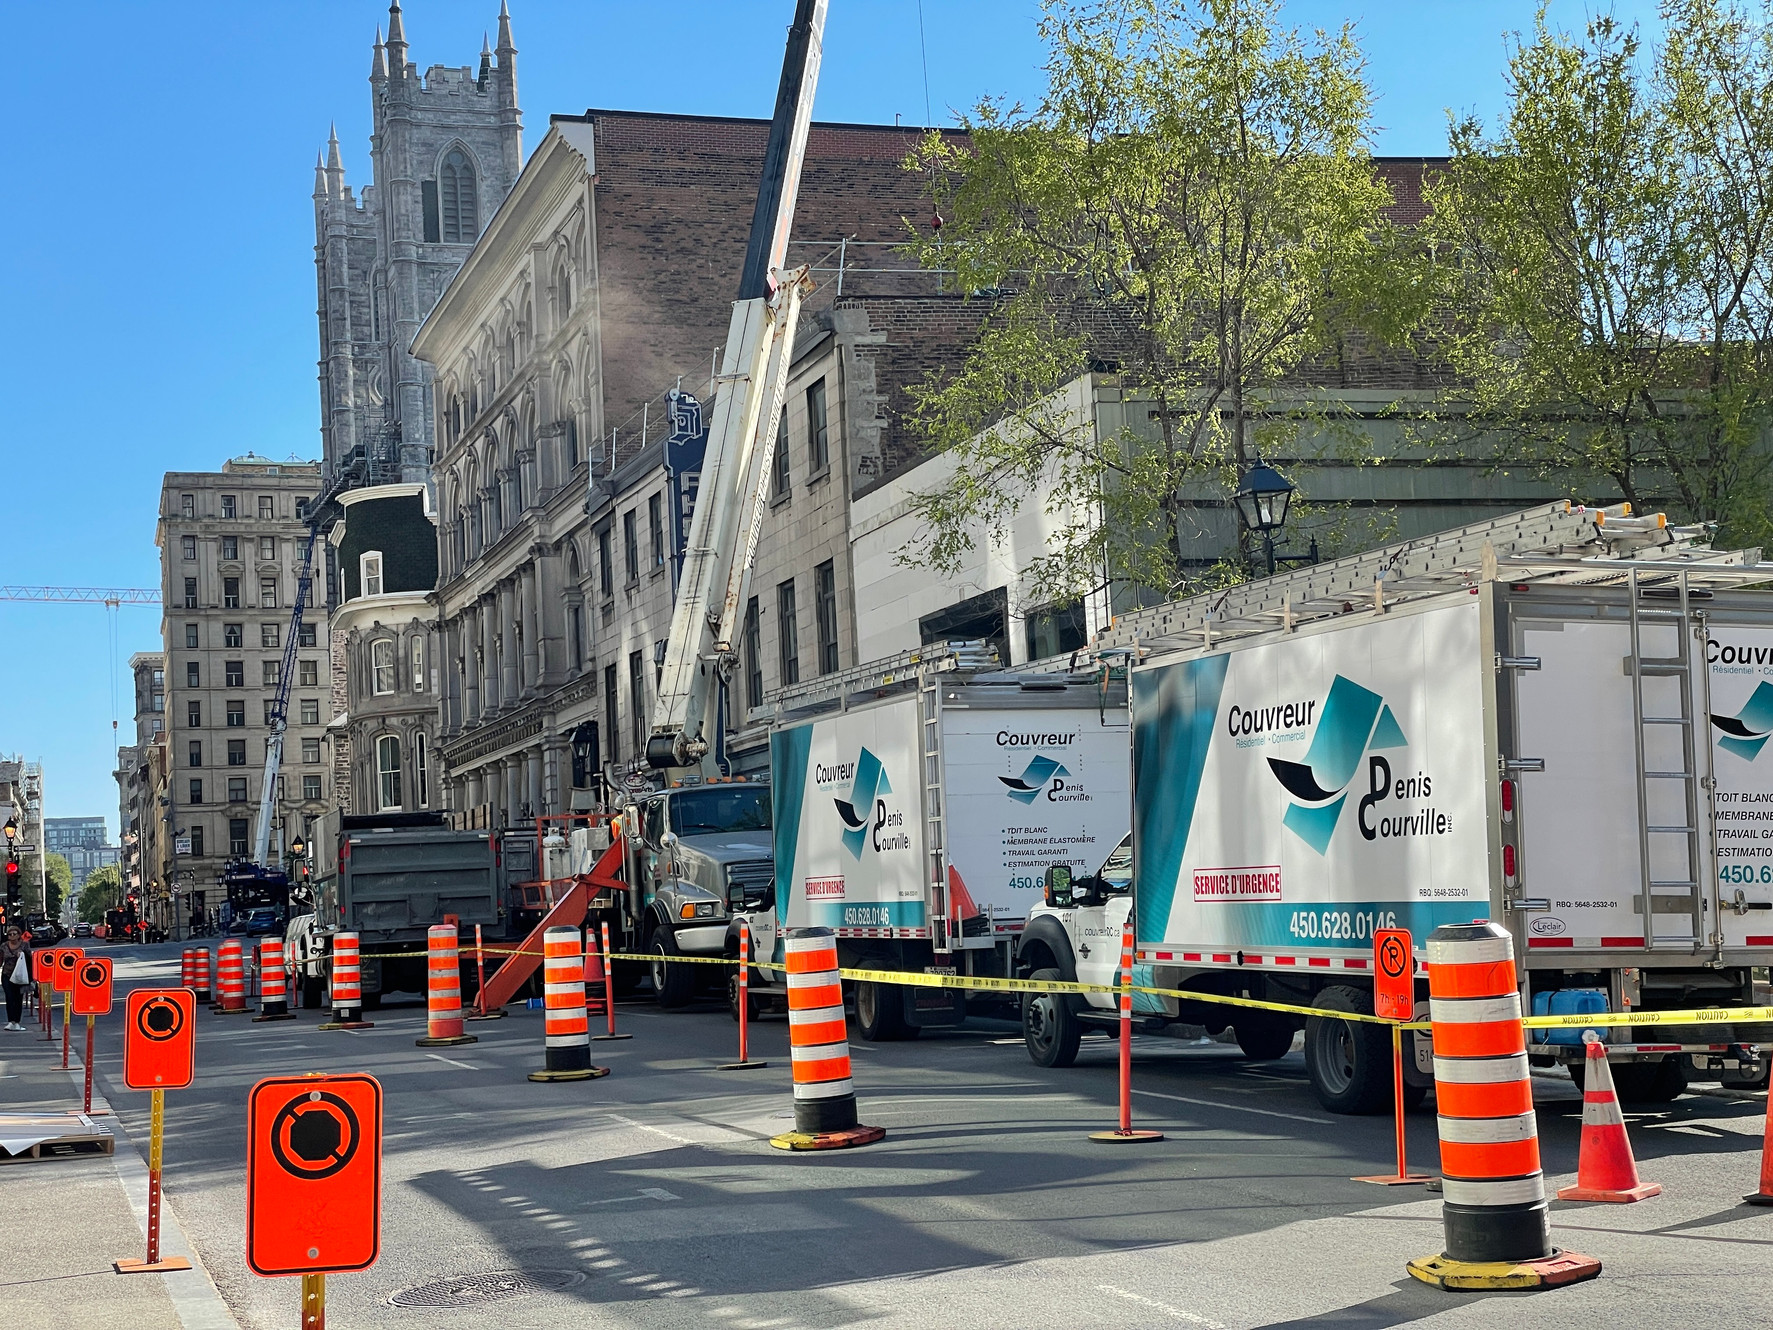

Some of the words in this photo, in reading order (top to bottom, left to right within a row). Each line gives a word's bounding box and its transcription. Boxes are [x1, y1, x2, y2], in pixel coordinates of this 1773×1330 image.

[1712, 665, 1754, 675] Résidentiel
[1228, 700, 1316, 737] Couvreur
[996, 731, 1076, 746] Couvreur
[1271, 730, 1306, 744] Commercial
[816, 762, 855, 784] Couvreur
[1369, 756, 1432, 801] Denis
[1053, 778, 1084, 792] Denis
[1716, 793, 1739, 803] TOIT
[876, 799, 903, 828] Denis
[1358, 793, 1446, 841] Courville
[873, 822, 909, 853] Courville
[1716, 829, 1759, 839] TRAVAIL
[1006, 837, 1048, 846] MEMBRANE
[1007, 849, 1036, 857] TRAVAIL
[1037, 848, 1069, 856] GARANTI
[1716, 847, 1773, 857] ESTIMATIO
[1007, 860, 1051, 868] ESTIMATION
[1051, 859, 1086, 867] GRATUITE
[805, 881, 822, 895] SERVICE
[822, 880, 845, 894] D'URGENCE
[1194, 875, 1230, 895] SERVICE
[1231, 873, 1280, 894] D'URGENCE
[844, 907, 890, 925] 450.628.0146
[1533, 921, 1562, 932] Leclair
[1380, 993, 1390, 1004] 7h
[1397, 994, 1409, 1005] 19h
[1562, 1016, 1594, 1025] CAUTION
[1628, 1013, 1660, 1023] CAUTION
[1696, 1010, 1729, 1021] CAUTION
